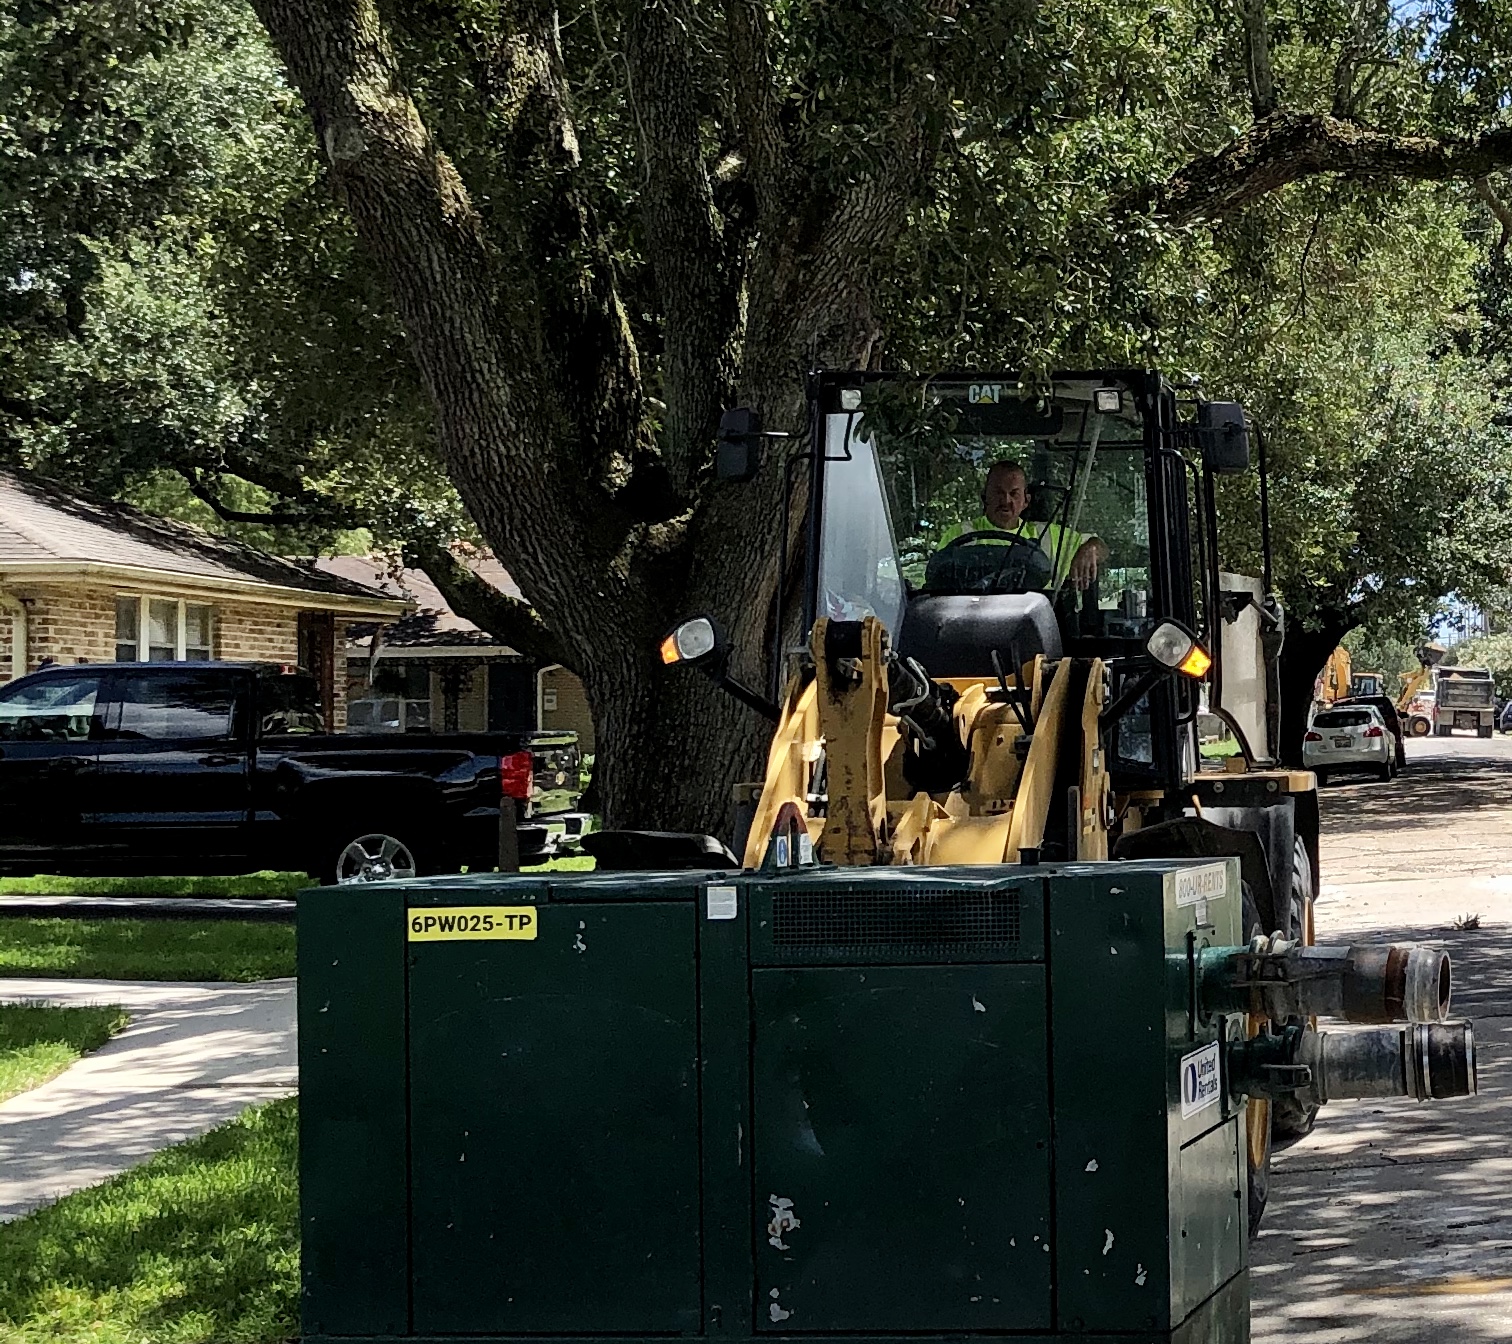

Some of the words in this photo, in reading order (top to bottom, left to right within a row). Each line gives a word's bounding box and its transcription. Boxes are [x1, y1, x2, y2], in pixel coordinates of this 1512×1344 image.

[968, 385, 1001, 404] CAT
[411, 914, 532, 933] 6PW025-TP
[1198, 1052, 1216, 1078] United
[1198, 1074, 1217, 1100] Rentals
